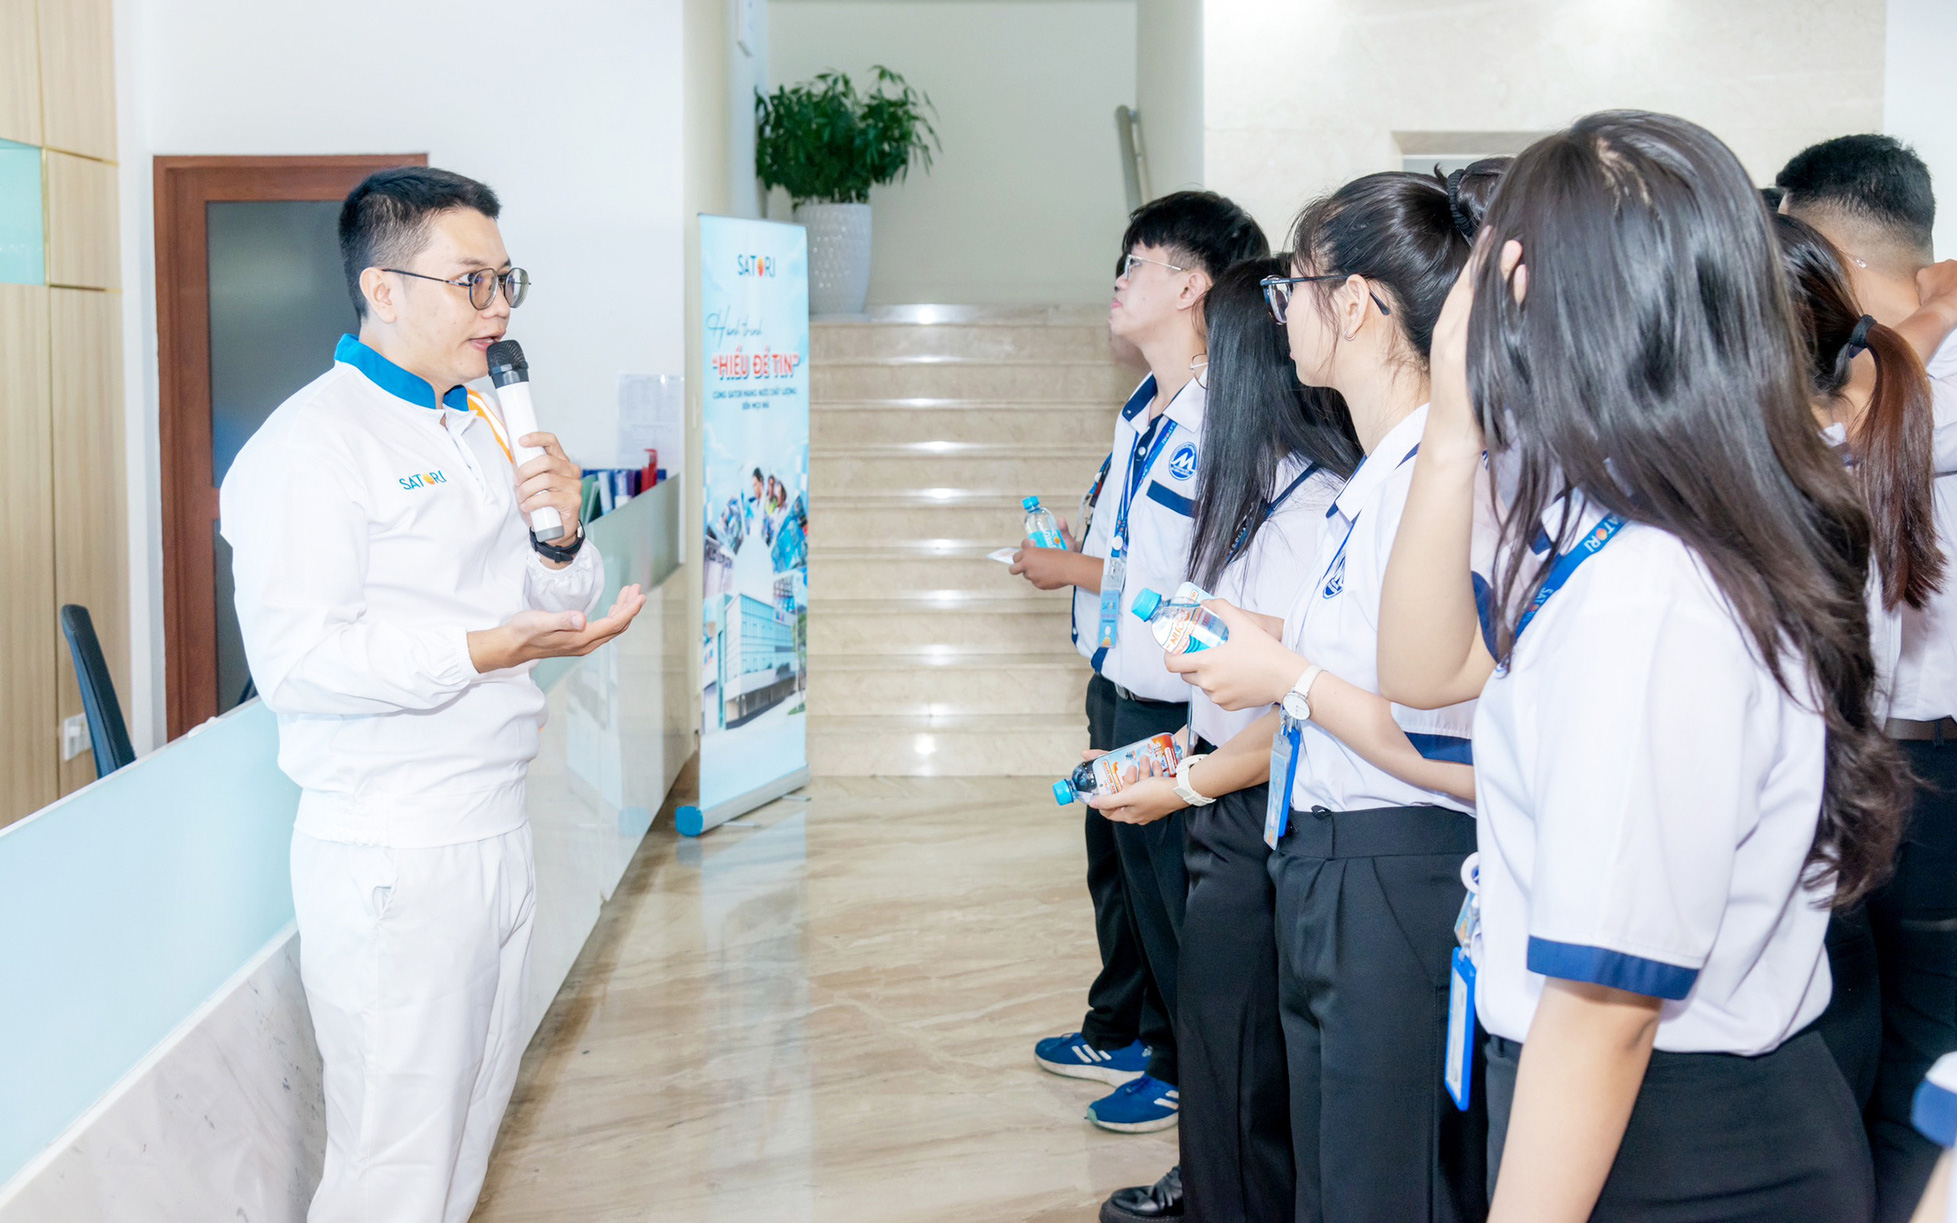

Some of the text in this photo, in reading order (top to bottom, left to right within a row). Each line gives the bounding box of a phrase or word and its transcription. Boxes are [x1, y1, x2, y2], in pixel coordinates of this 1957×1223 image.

[737, 254, 775, 277] SATORI
[399, 470, 447, 490] SATORI
[1584, 515, 1619, 552] ATORI
